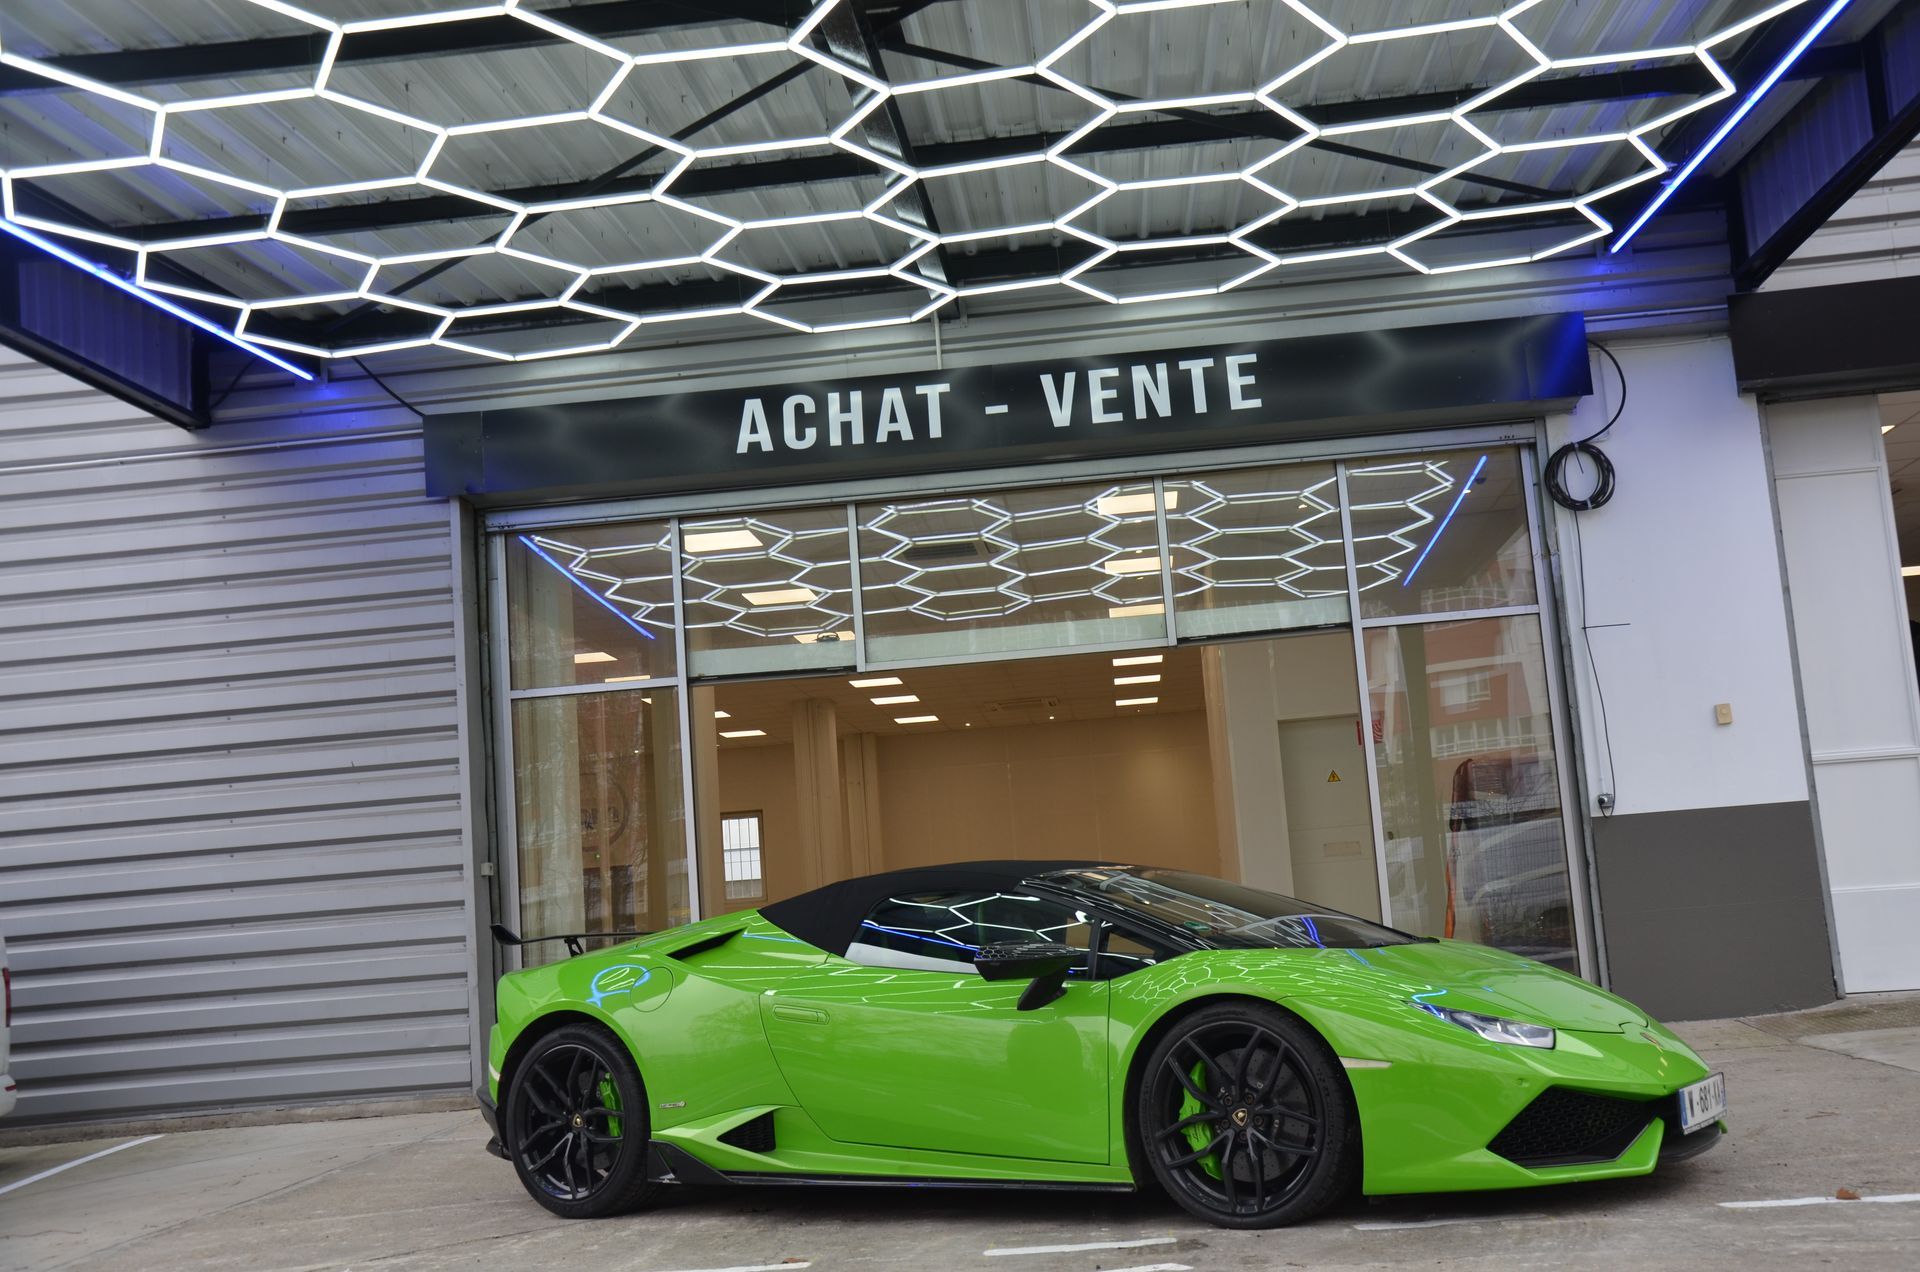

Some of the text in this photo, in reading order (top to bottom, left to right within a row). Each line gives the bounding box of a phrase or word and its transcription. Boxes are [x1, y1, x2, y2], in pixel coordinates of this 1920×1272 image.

[736, 353, 1263, 454] ACHAT - VENTE
